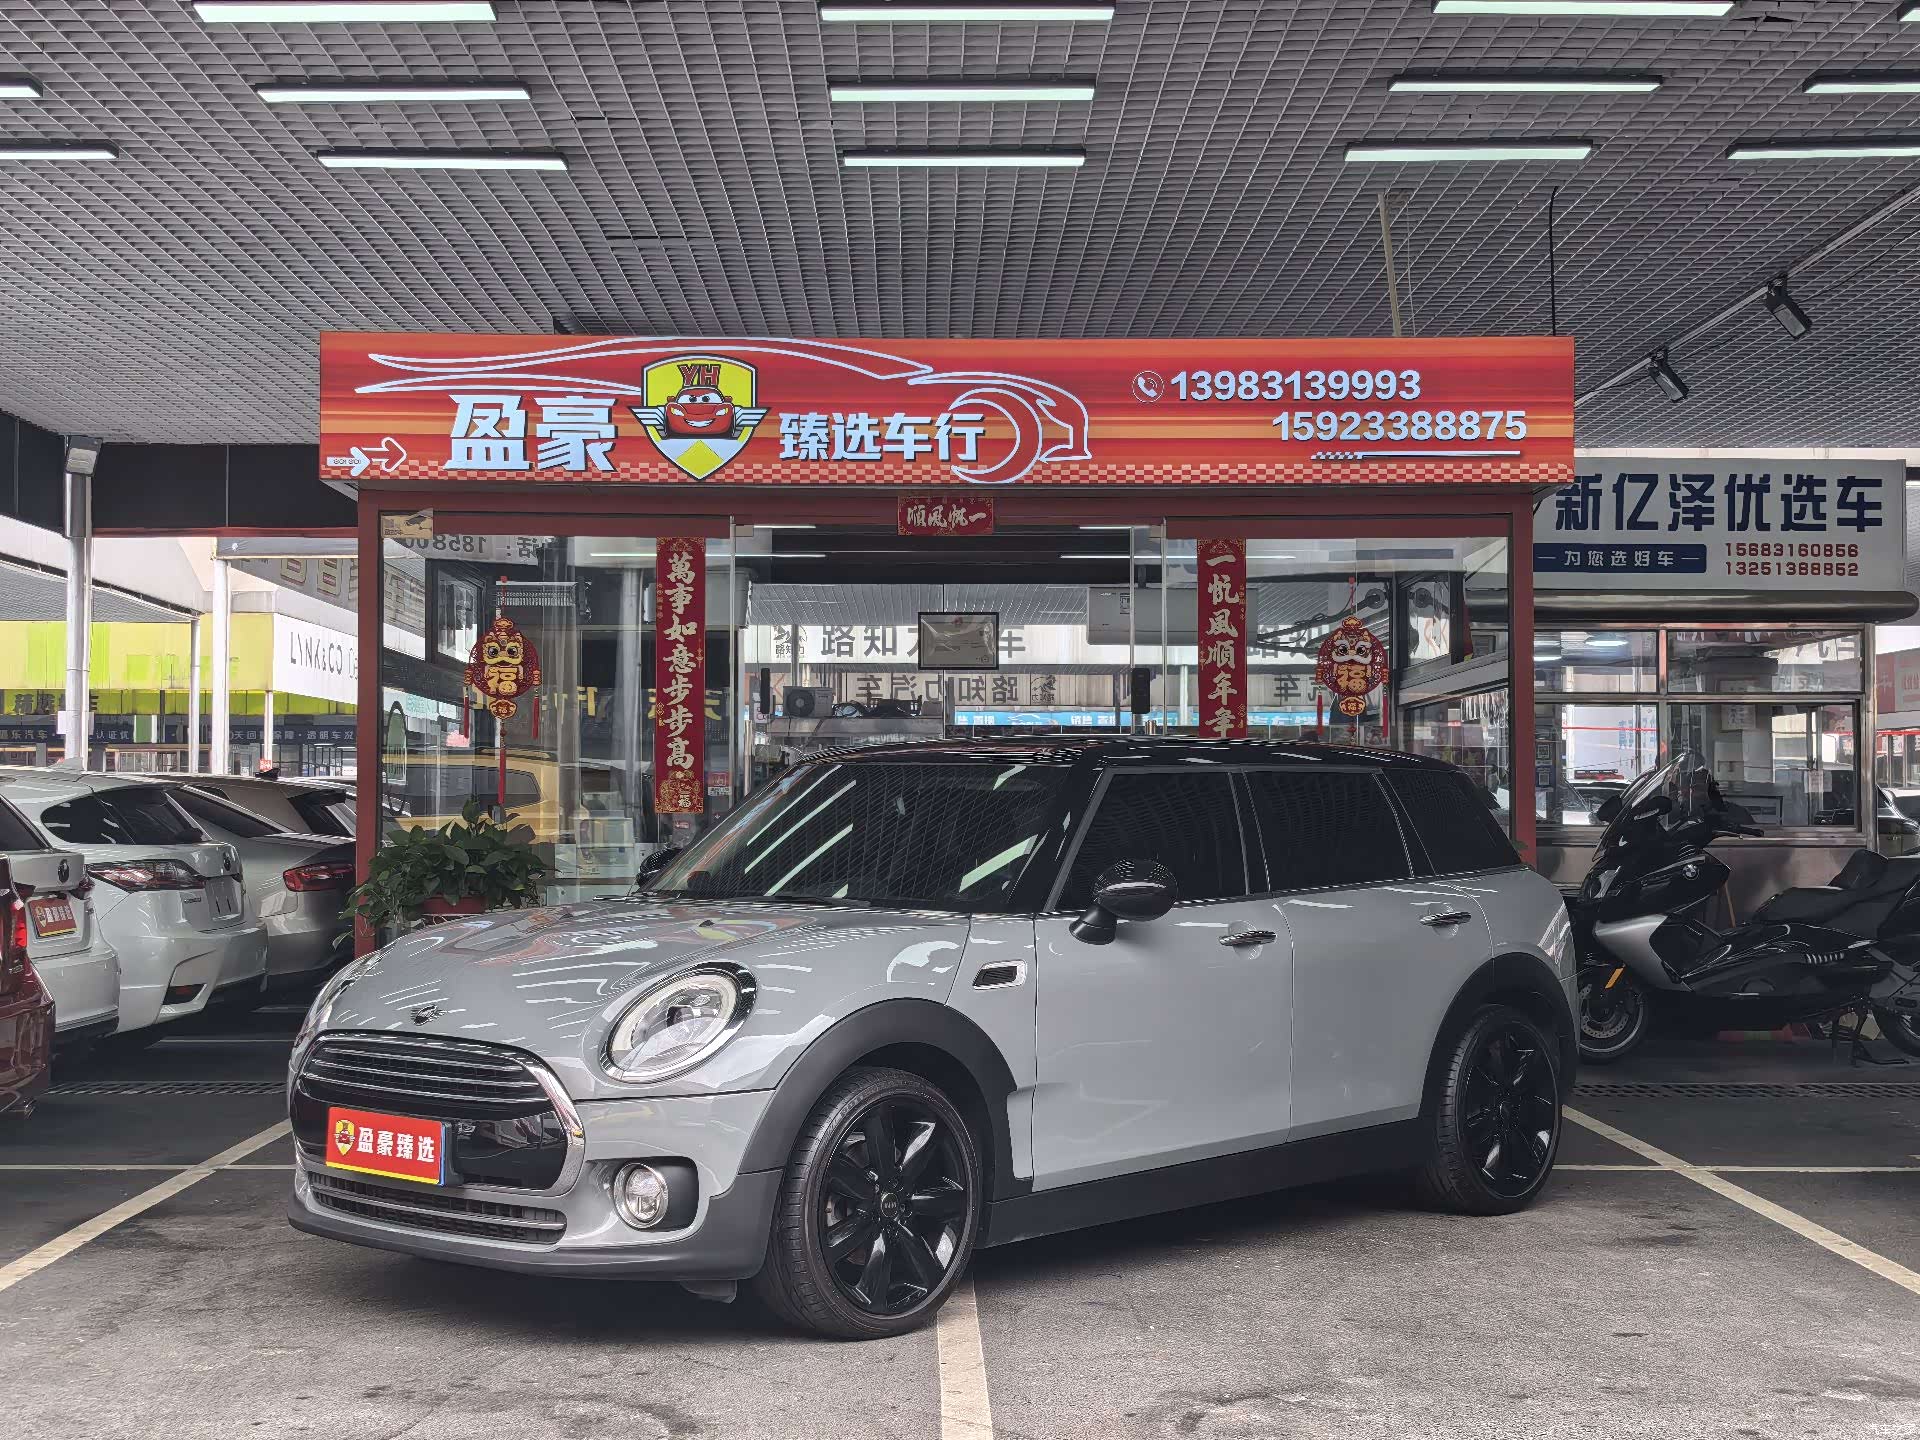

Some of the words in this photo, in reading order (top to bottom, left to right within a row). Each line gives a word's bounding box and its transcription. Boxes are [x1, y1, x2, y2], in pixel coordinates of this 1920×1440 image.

[677, 363, 721, 387] YH
[1171, 370, 1421, 401] 13983139993
[443, 394, 617, 472] 盈豪
[779, 412, 984, 461] 臻选车行
[1272, 410, 1527, 441] 15923388875
[1555, 473, 1883, 532] 新亿泽优选车
[1564, 550, 1674, 567] 为您选好车
[1725, 543, 1859, 557] 15683160856
[1725, 562, 1859, 576] 13251388852
[488, 666, 518, 695] 福
[1338, 664, 1367, 692] 福
[356, 1127, 435, 1162] 盈豪臻选
